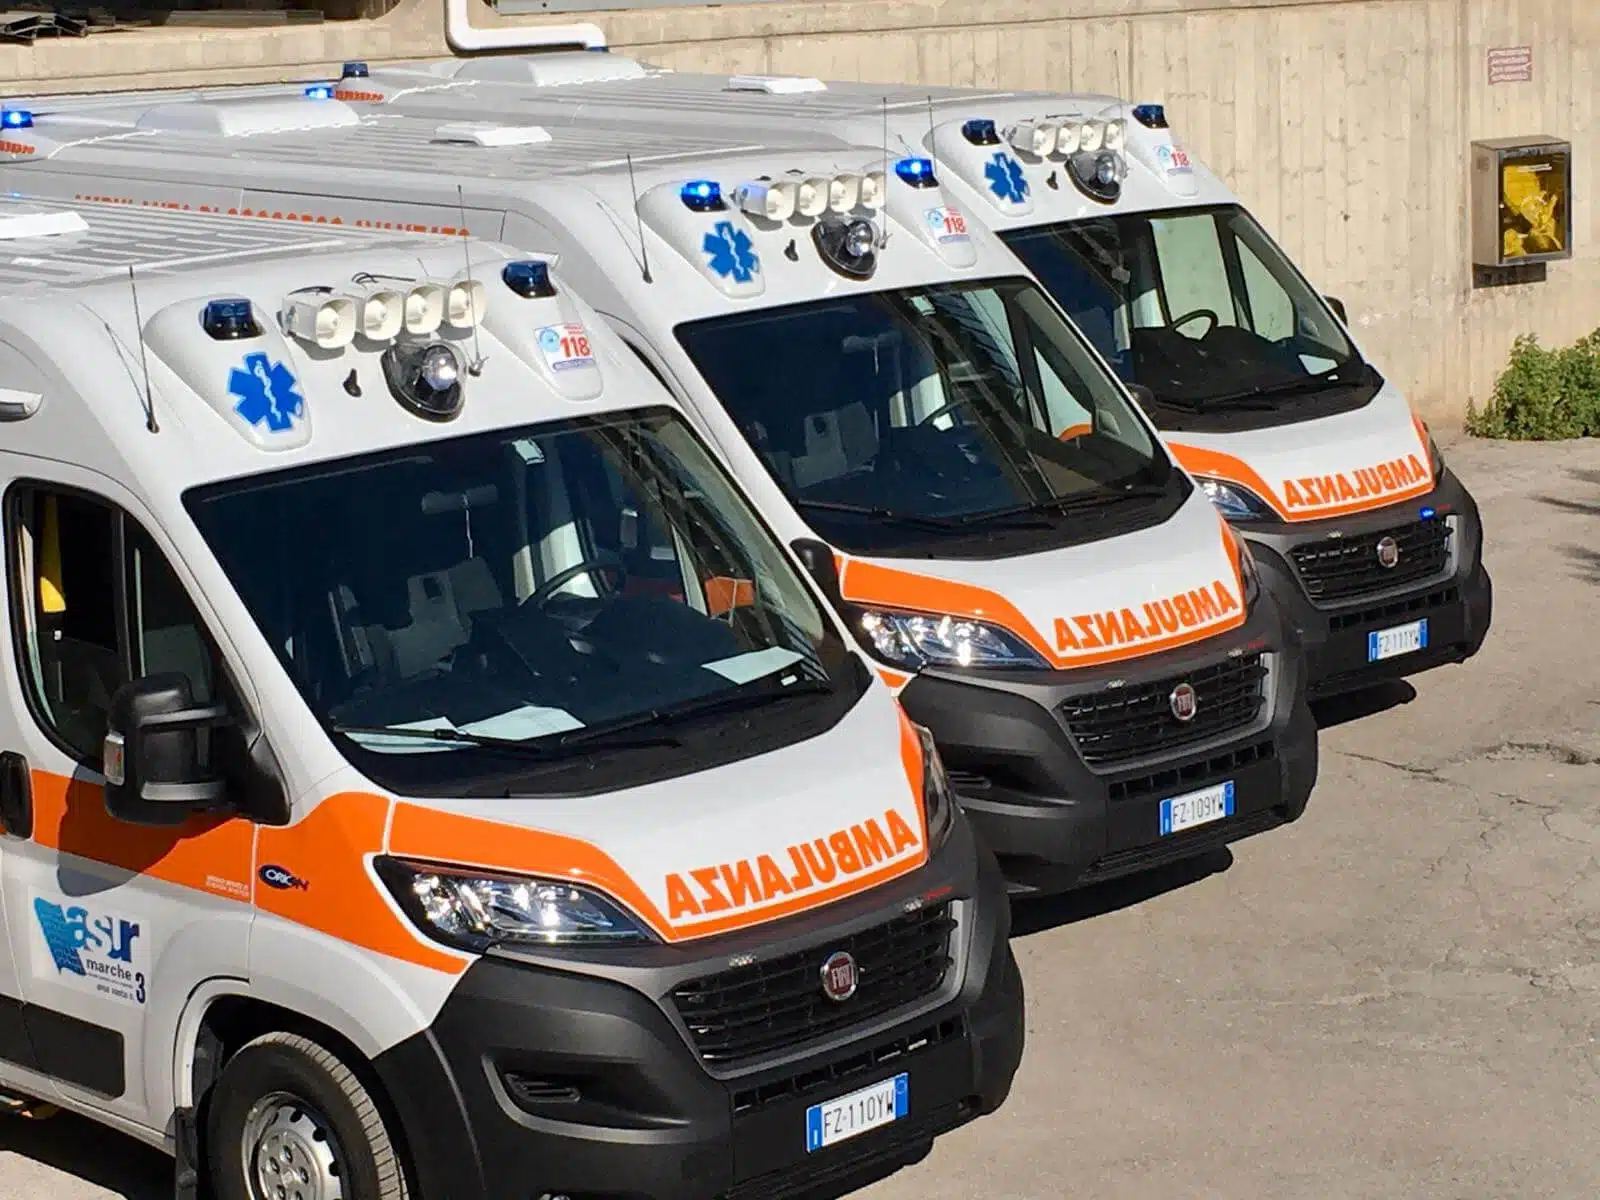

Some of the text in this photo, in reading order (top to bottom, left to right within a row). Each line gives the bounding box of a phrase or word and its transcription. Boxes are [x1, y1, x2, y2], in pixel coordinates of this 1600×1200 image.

[944, 216, 966, 233] 118
[560, 336, 590, 357] 118
[66, 906, 140, 963] asur
[86, 959, 132, 981] marche
[135, 971, 146, 1004] 3
